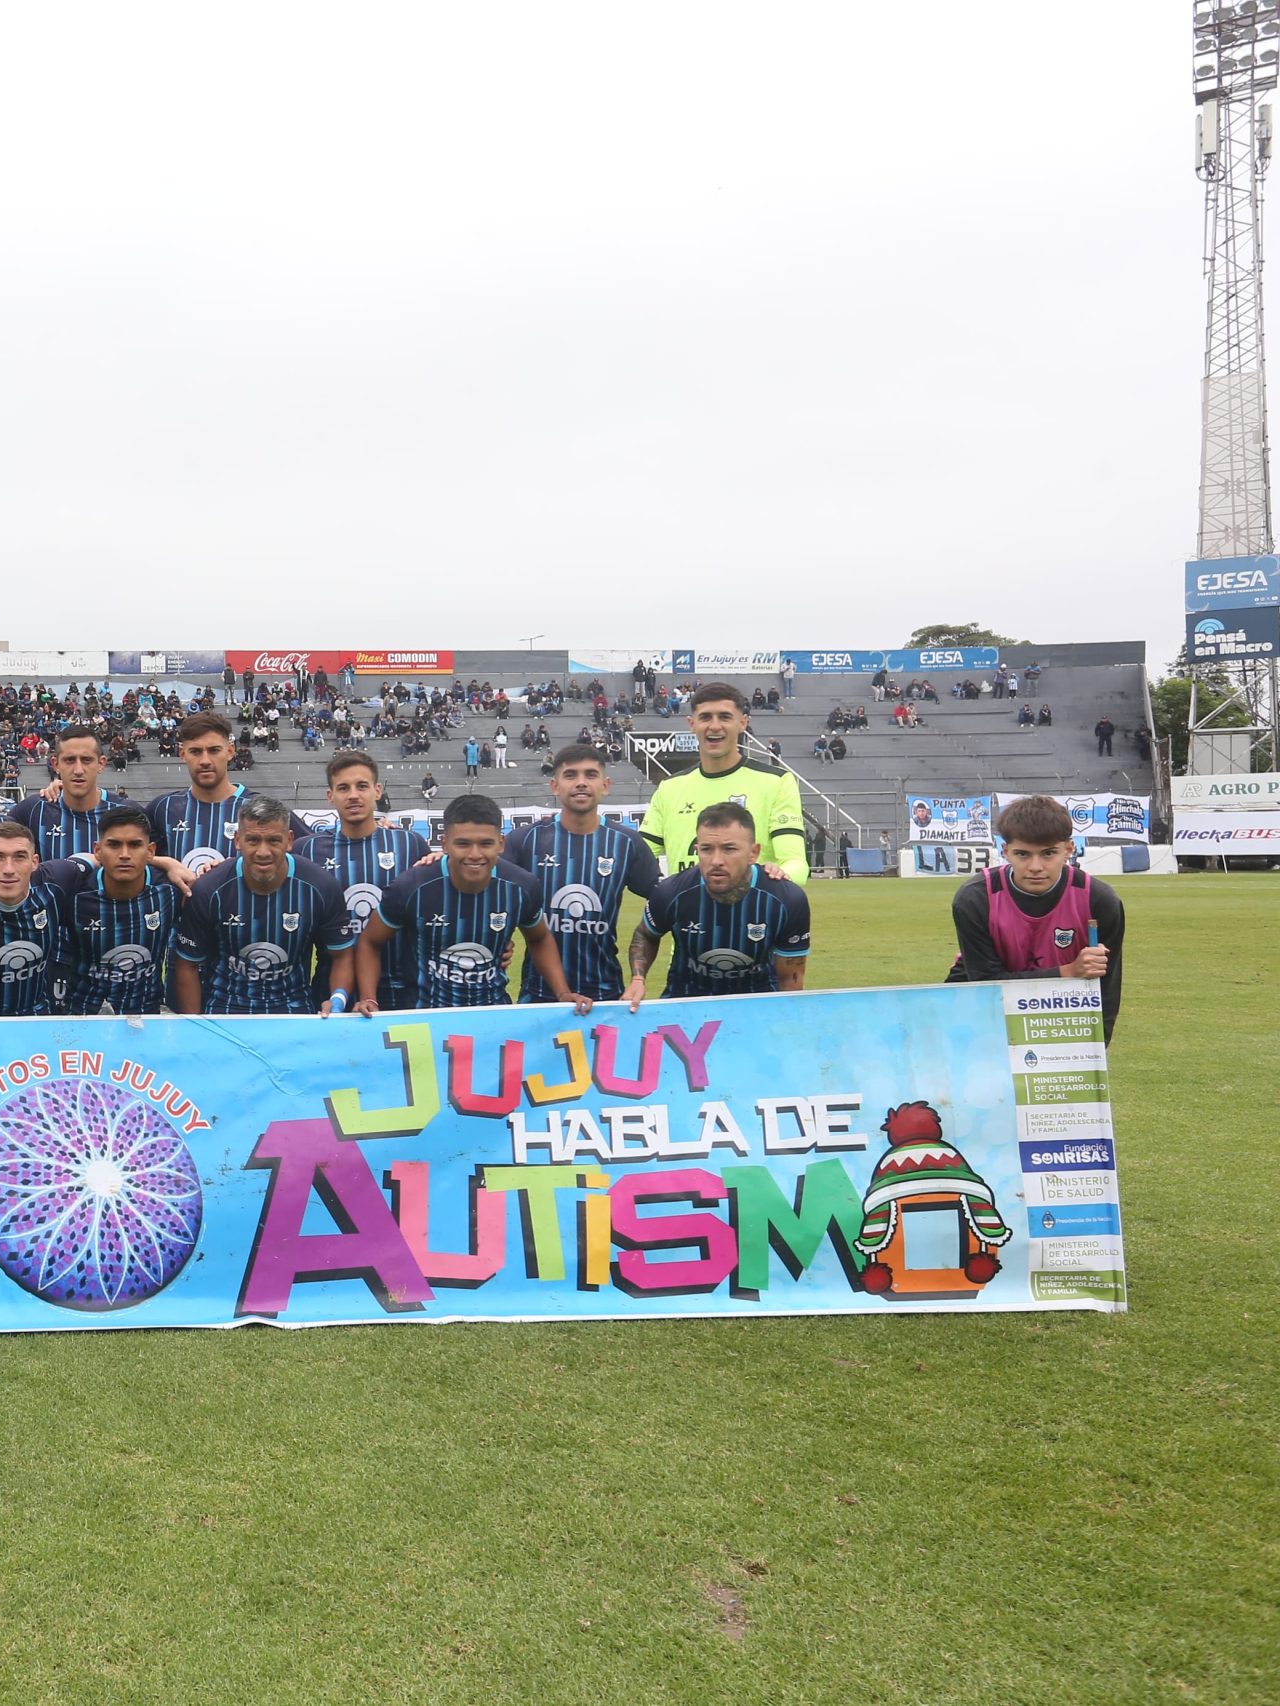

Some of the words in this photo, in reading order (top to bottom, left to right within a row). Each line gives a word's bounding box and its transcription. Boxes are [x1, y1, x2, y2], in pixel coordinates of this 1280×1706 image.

[1197, 569, 1269, 591] EJESA
[1194, 629, 1247, 645] Pensá
[1194, 645, 1216, 657] en
[1219, 641, 1273, 655] Macro
[356, 652, 384, 663] Maxi
[388, 653, 437, 663] COMODIN
[697, 655, 709, 663] En
[711, 655, 736, 665] Jujuy
[752, 652, 778, 664] RM
[812, 653, 853, 666] EJESA
[920, 650, 963, 664] EJESA
[1208, 782, 1261, 795] AGRO
[933, 799, 966, 809] PUNTA
[919, 830, 967, 841] DIAMANTE
[917, 845, 951, 872] LA
[957, 848, 991, 873] 33
[543, 911, 609, 935] Macro
[89, 962, 156, 983] Macro
[228, 956, 293, 981] Macro
[427, 958, 497, 985] Macro
[1052, 989, 1099, 998] Fundación
[1017, 996, 1101, 1010] SONRISAS
[1029, 1016, 1099, 1027] MINISTERIO
[1031, 1029, 1048, 1039] DE
[1051, 1027, 1092, 1038] SALUD
[324, 1020, 723, 1142] JUJUY
[1033, 1075, 1084, 1084] MINISTERIO
[58, 1050, 104, 1078] EN
[110, 1059, 212, 1135] JUJUY
[1034, 1085, 1047, 1093] DE
[1048, 1083, 1106, 1092] DESARROLLO
[1035, 1093, 1068, 1101] SOCIAL
[1030, 1112, 1076, 1120] SECRETARIA
[508, 1100, 752, 1166] HABLA
[756, 1092, 870, 1157] DE
[1031, 1151, 1110, 1165] SONRISAS
[1046, 1176, 1110, 1187] MINISTERIO
[1048, 1189, 1064, 1199] DE
[1067, 1187, 1104, 1198] SALUD
[1048, 1240, 1100, 1249] MINISTERIO
[1049, 1259, 1083, 1267] SOCIAL
